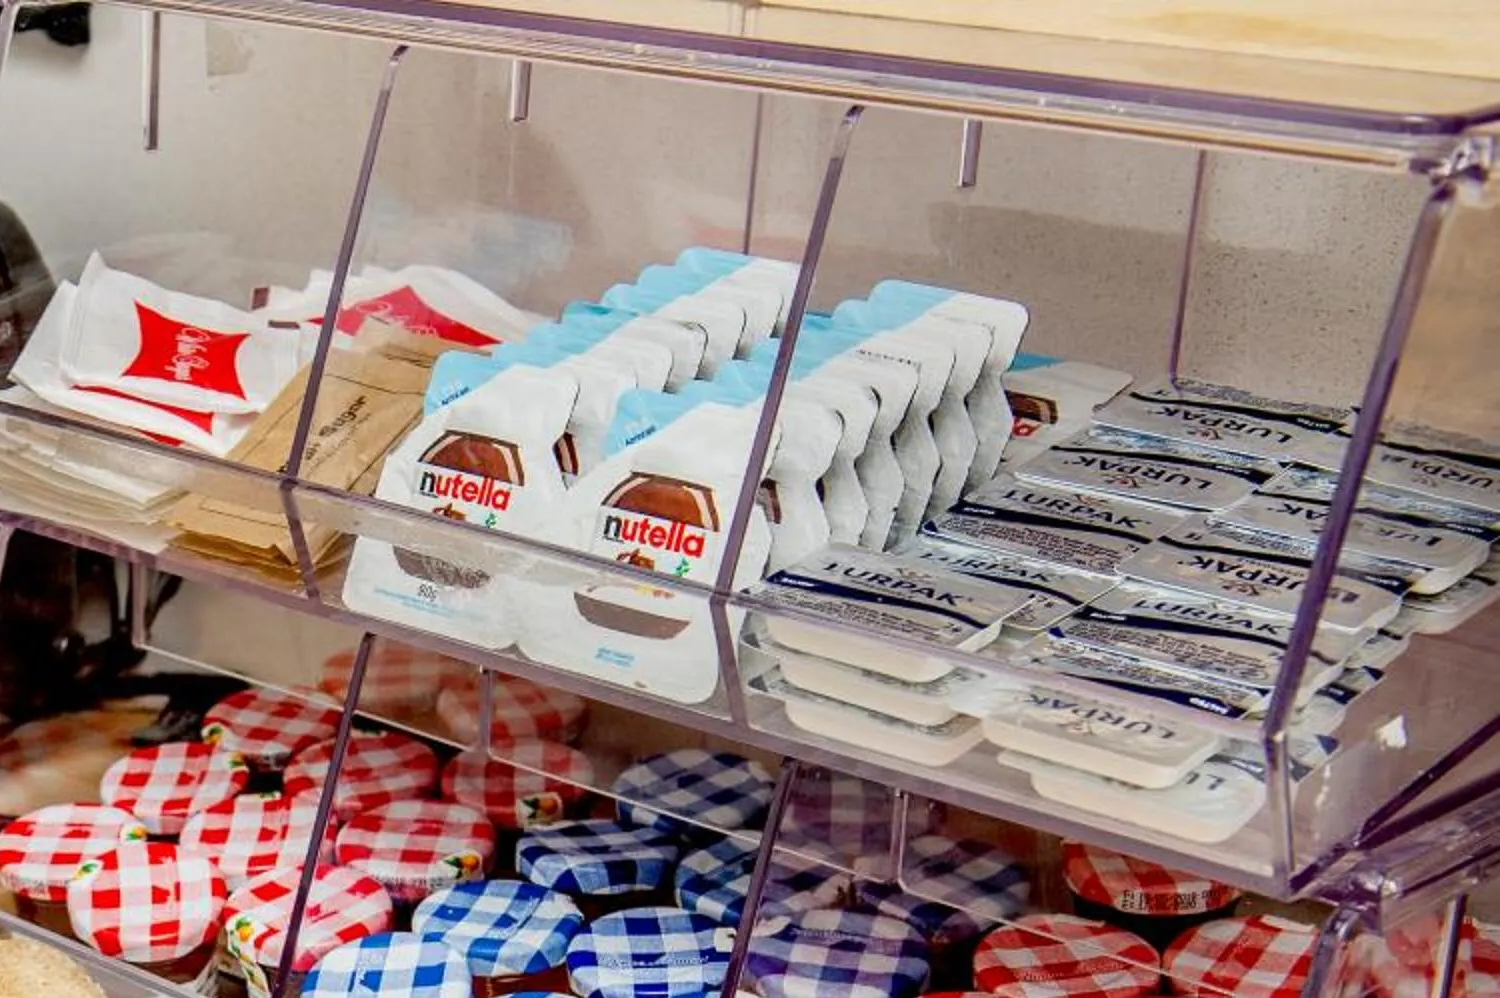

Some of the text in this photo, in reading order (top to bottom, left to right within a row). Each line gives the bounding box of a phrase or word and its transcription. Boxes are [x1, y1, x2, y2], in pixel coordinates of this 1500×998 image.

[1161, 405, 1293, 443] LURPAK
[419, 470, 512, 511] nutella
[1071, 454, 1213, 490] LURPAK
[1003, 489, 1144, 529] LURPAK
[603, 514, 705, 558] nutella
[823, 562, 967, 606] LURPAK
[1133, 599, 1287, 635] LURPAK
[1027, 692, 1175, 740] LURPAK
